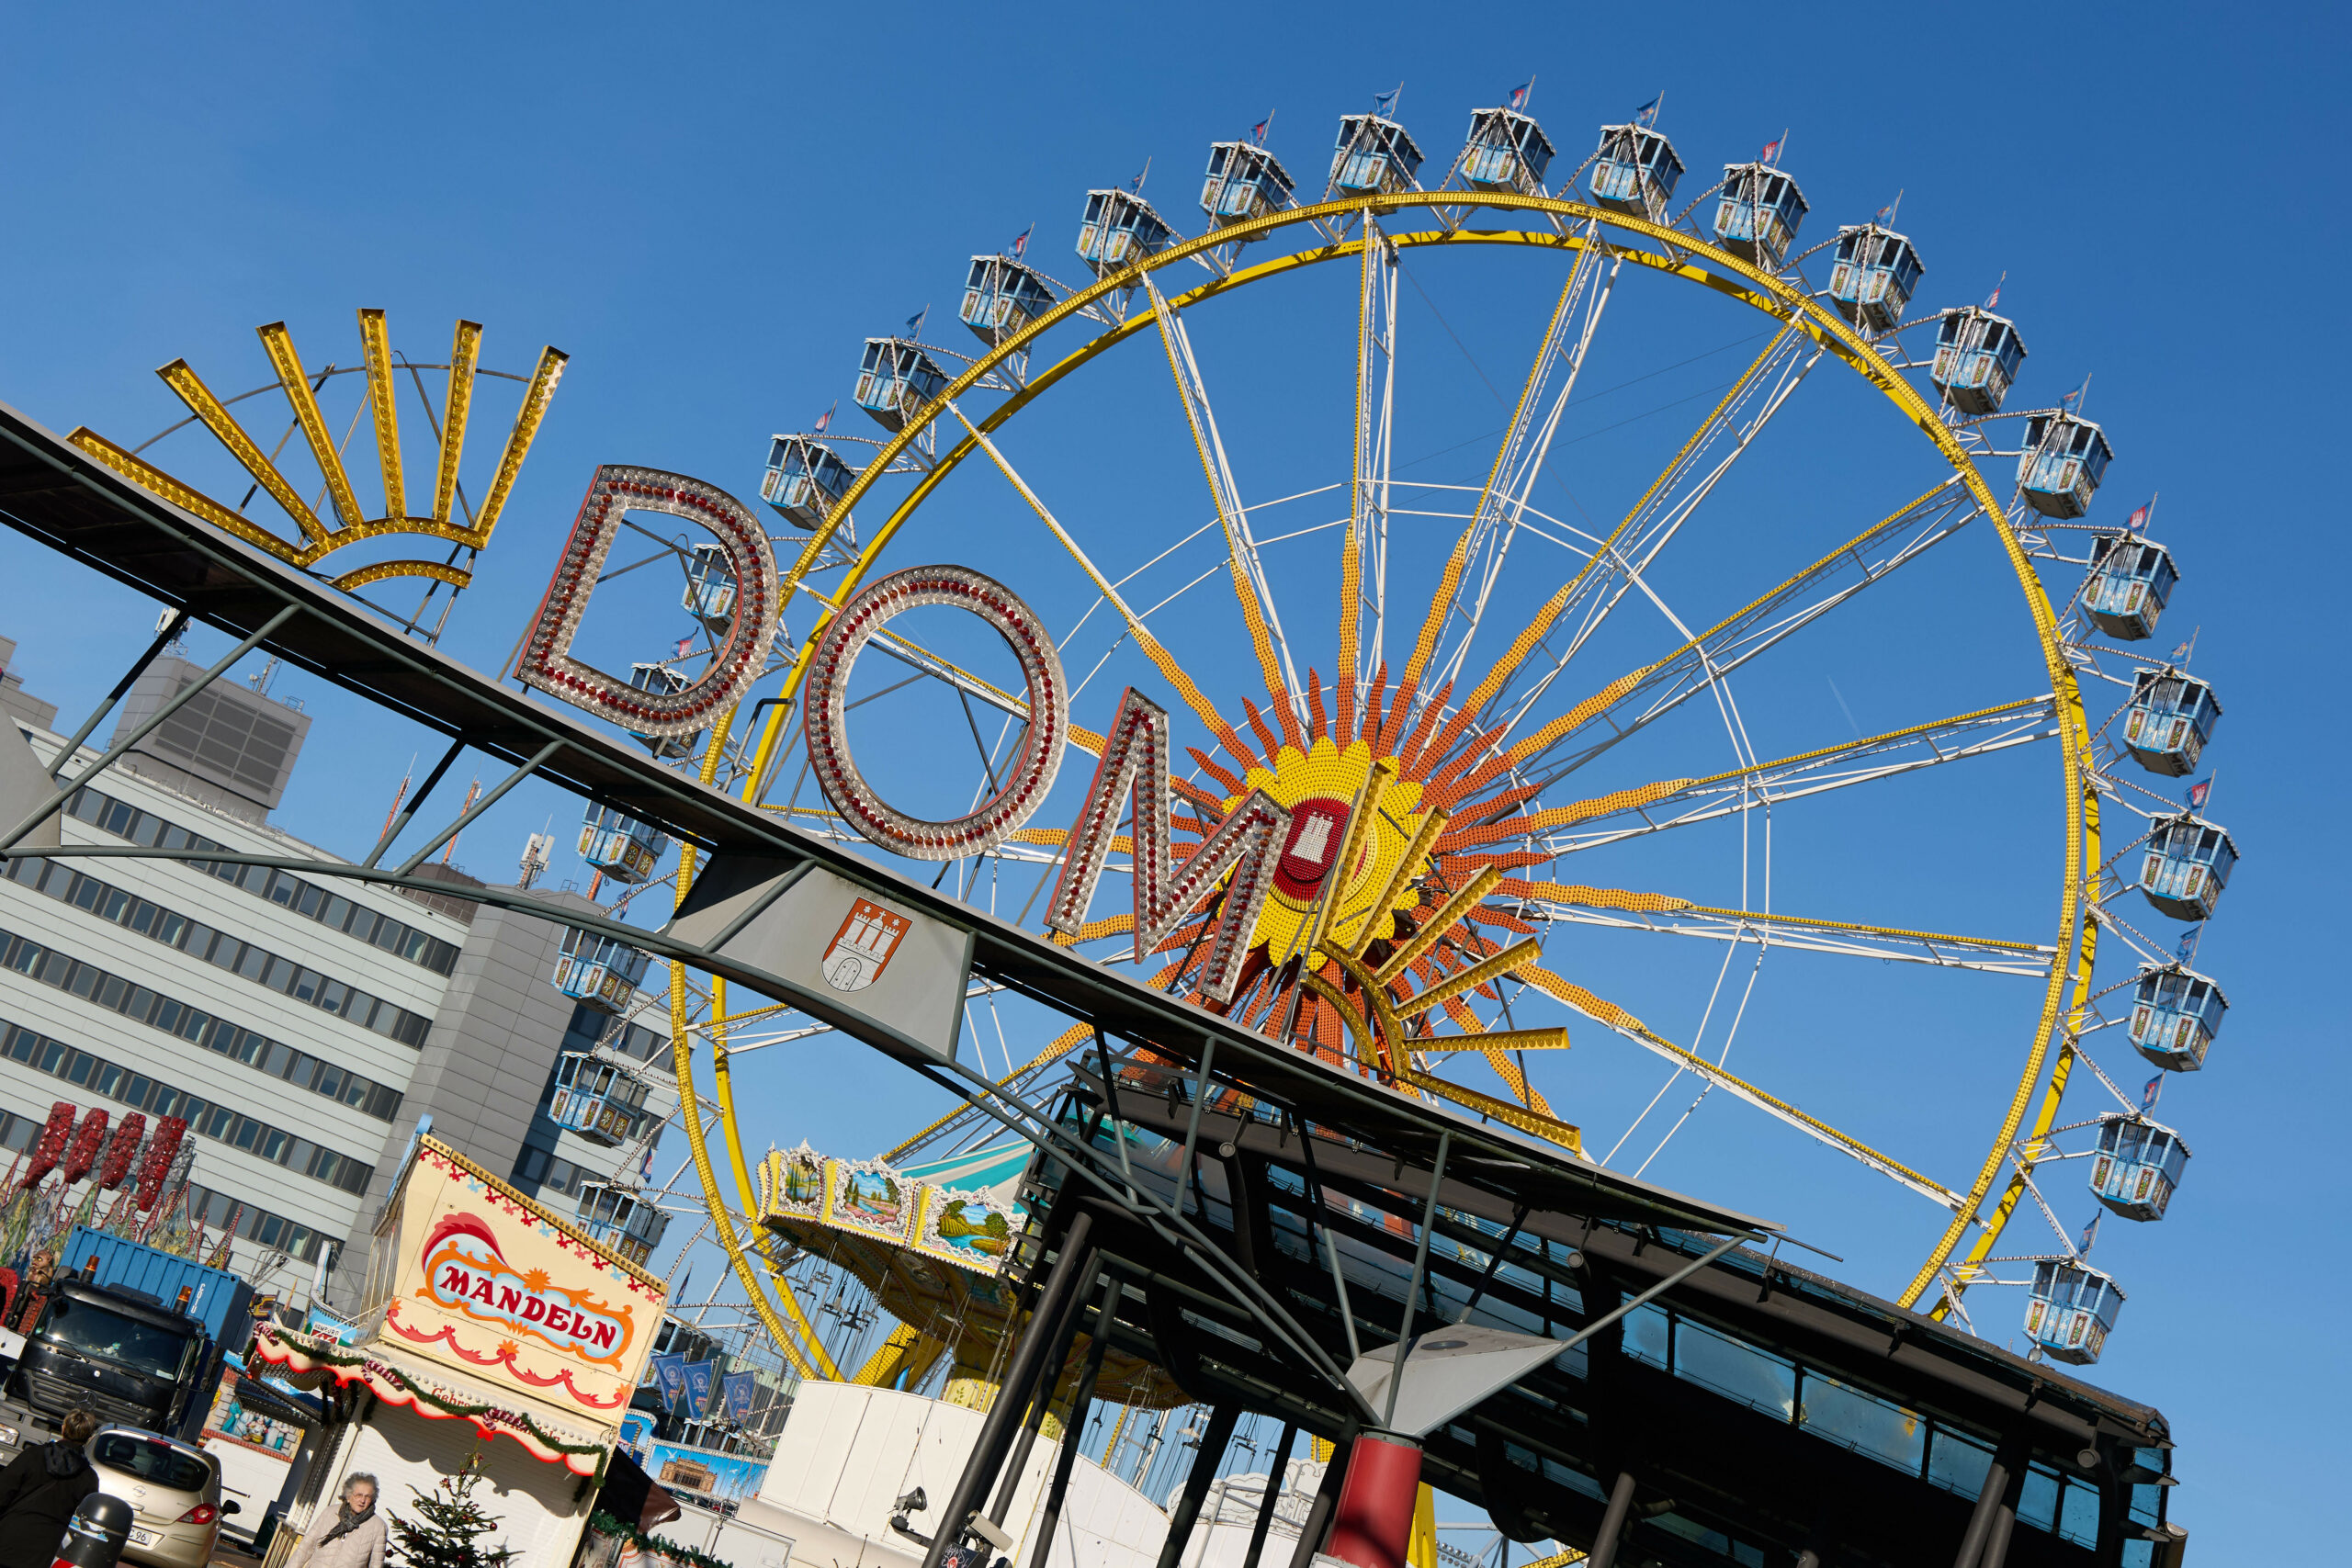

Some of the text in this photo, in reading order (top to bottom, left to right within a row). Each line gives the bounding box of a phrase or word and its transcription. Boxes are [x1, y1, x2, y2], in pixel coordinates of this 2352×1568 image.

[513, 465, 1293, 1004] DOM
[439, 1266, 616, 1349] MANDELN
[136, 1531, 147, 1541] 96
